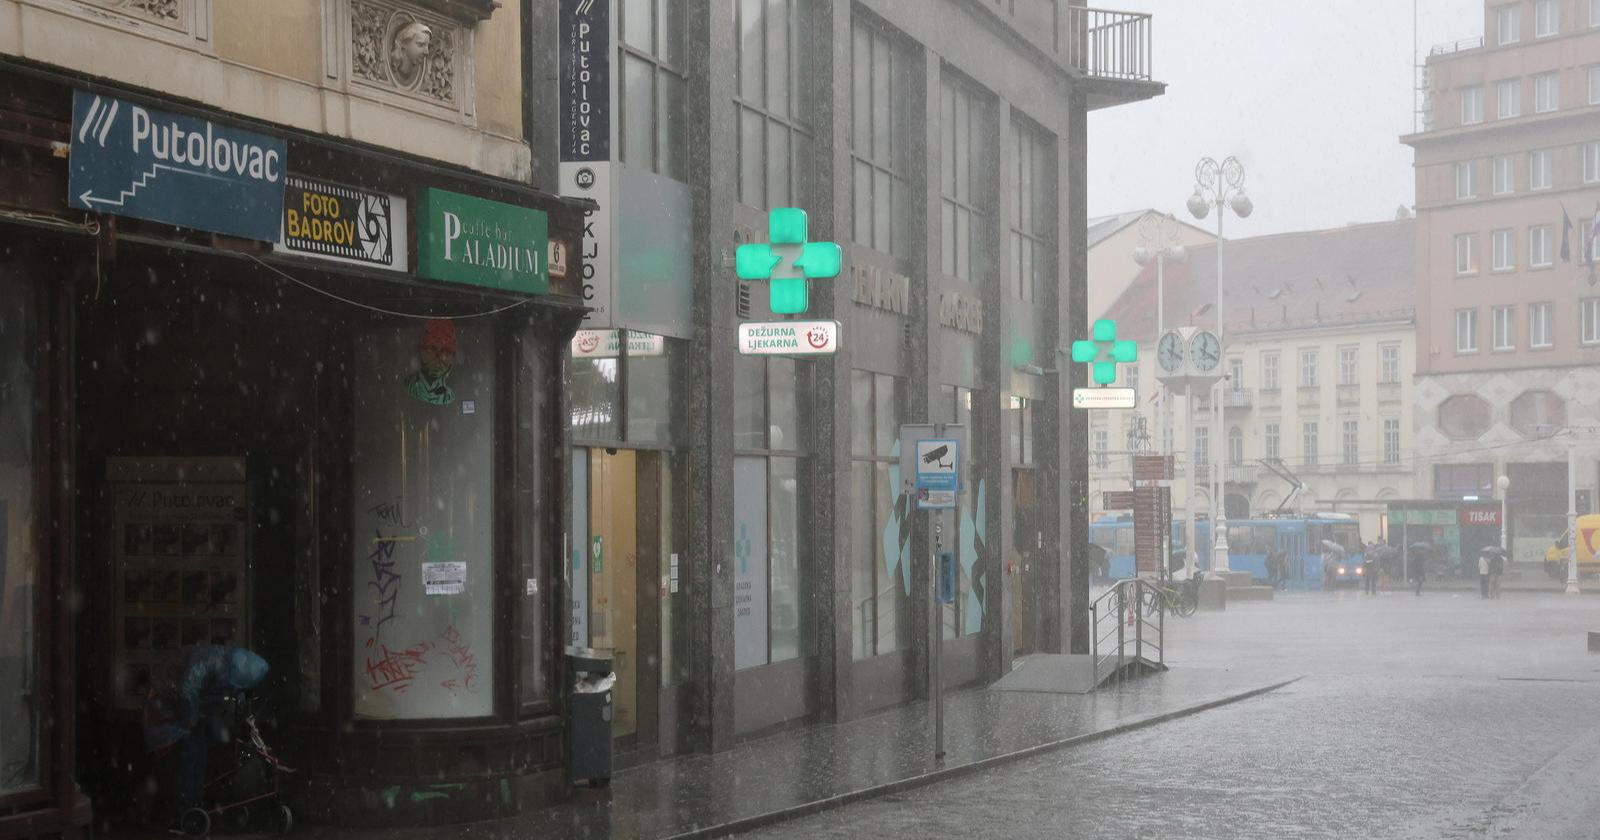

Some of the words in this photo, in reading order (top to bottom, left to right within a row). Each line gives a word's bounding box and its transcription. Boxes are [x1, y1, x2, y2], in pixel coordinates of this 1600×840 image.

[579, 23, 590, 155] Putolovac
[132, 106, 279, 182] Putolovac
[303, 192, 339, 218] FOTO
[287, 208, 354, 246] BADROV
[443, 211, 539, 275] PALADIUM
[553, 242, 560, 264] 6
[748, 325, 796, 337] DEŽURNA
[813, 333, 824, 342] 24
[748, 339, 798, 350] LJEKARNA
[1469, 512, 1497, 522] TISAK
